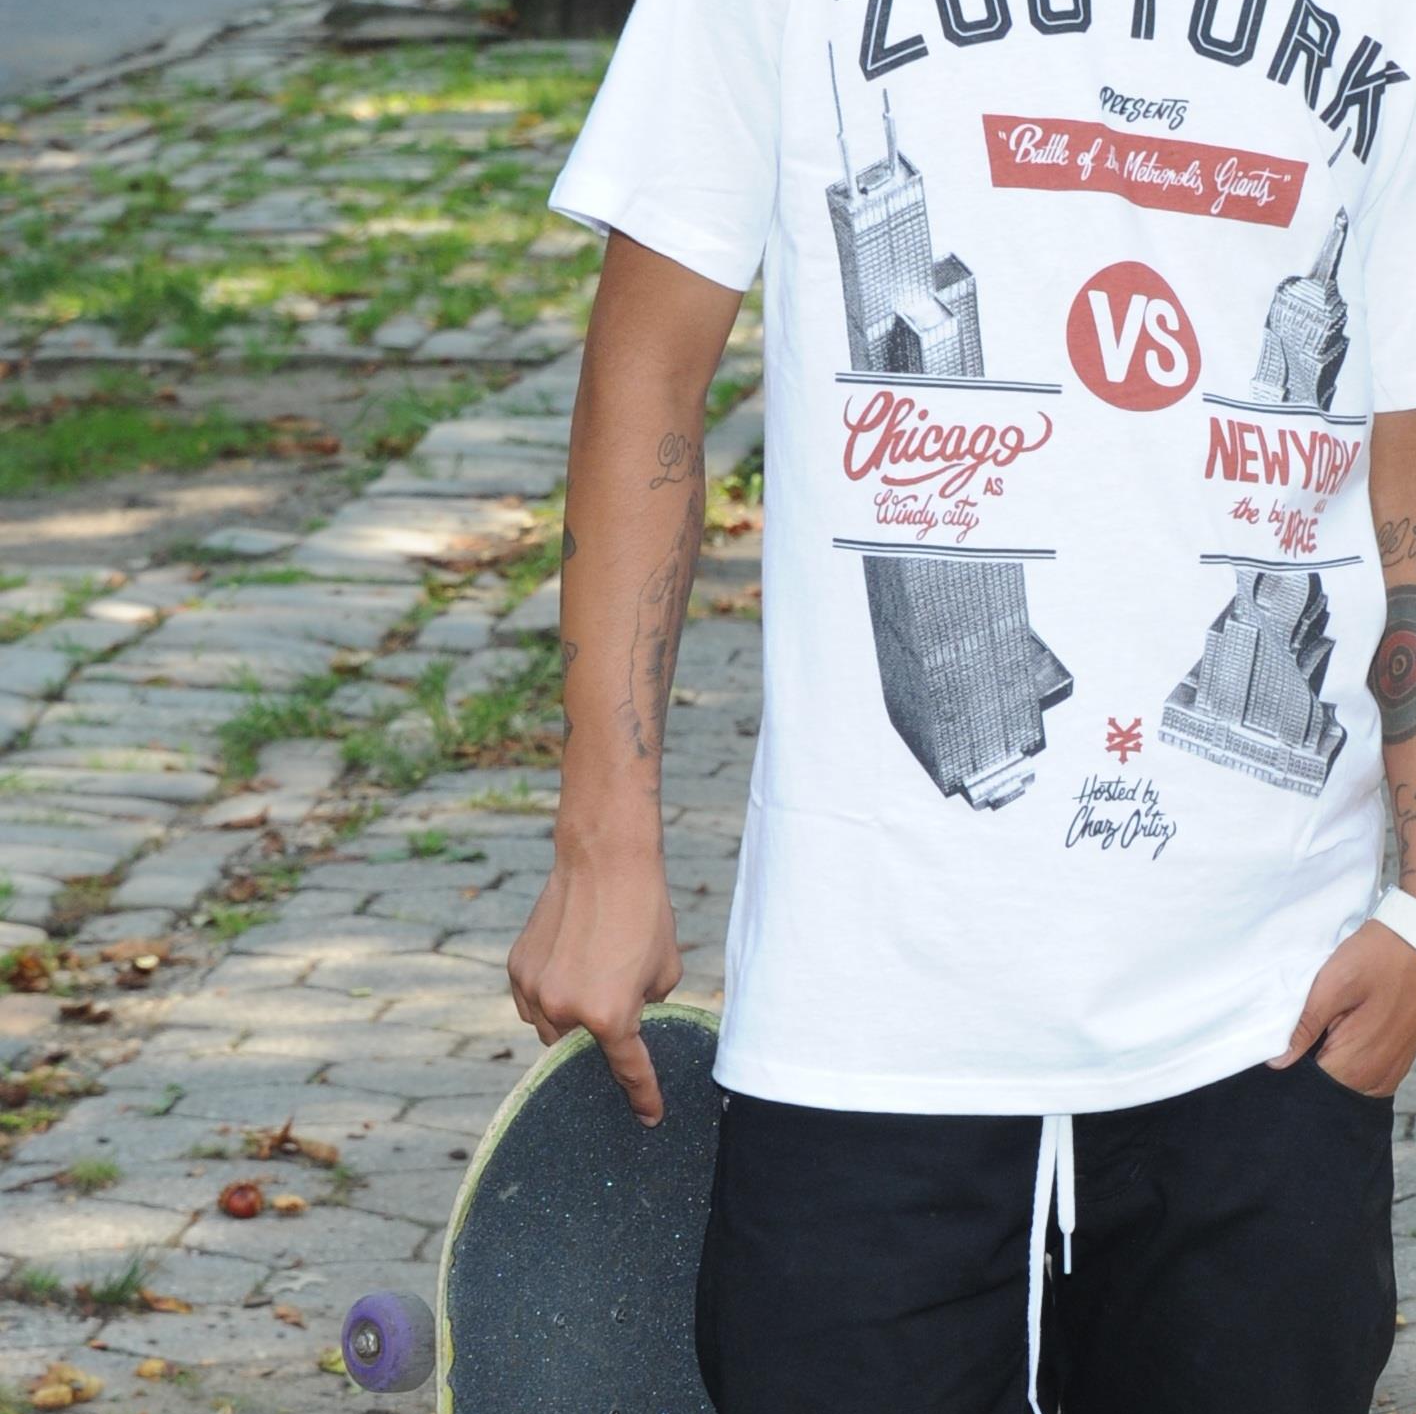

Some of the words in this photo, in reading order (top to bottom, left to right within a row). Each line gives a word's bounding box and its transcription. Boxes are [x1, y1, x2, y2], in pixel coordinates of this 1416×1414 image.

[1099, 85, 1190, 130] PRESENTS
[1076, 138, 1103, 181] of
[1087, 289, 1190, 388] VS
[843, 390, 1053, 499] Chicago
[873, 489, 939, 541] Windy
[942, 494, 980, 544] city
[1227, 496, 1260, 524] the
[1072, 774, 1142, 805] Hosted
[1141, 778, 1160, 818] by
[1065, 805, 1124, 850] Chaz
[1120, 809, 1177, 861] Ortiz
